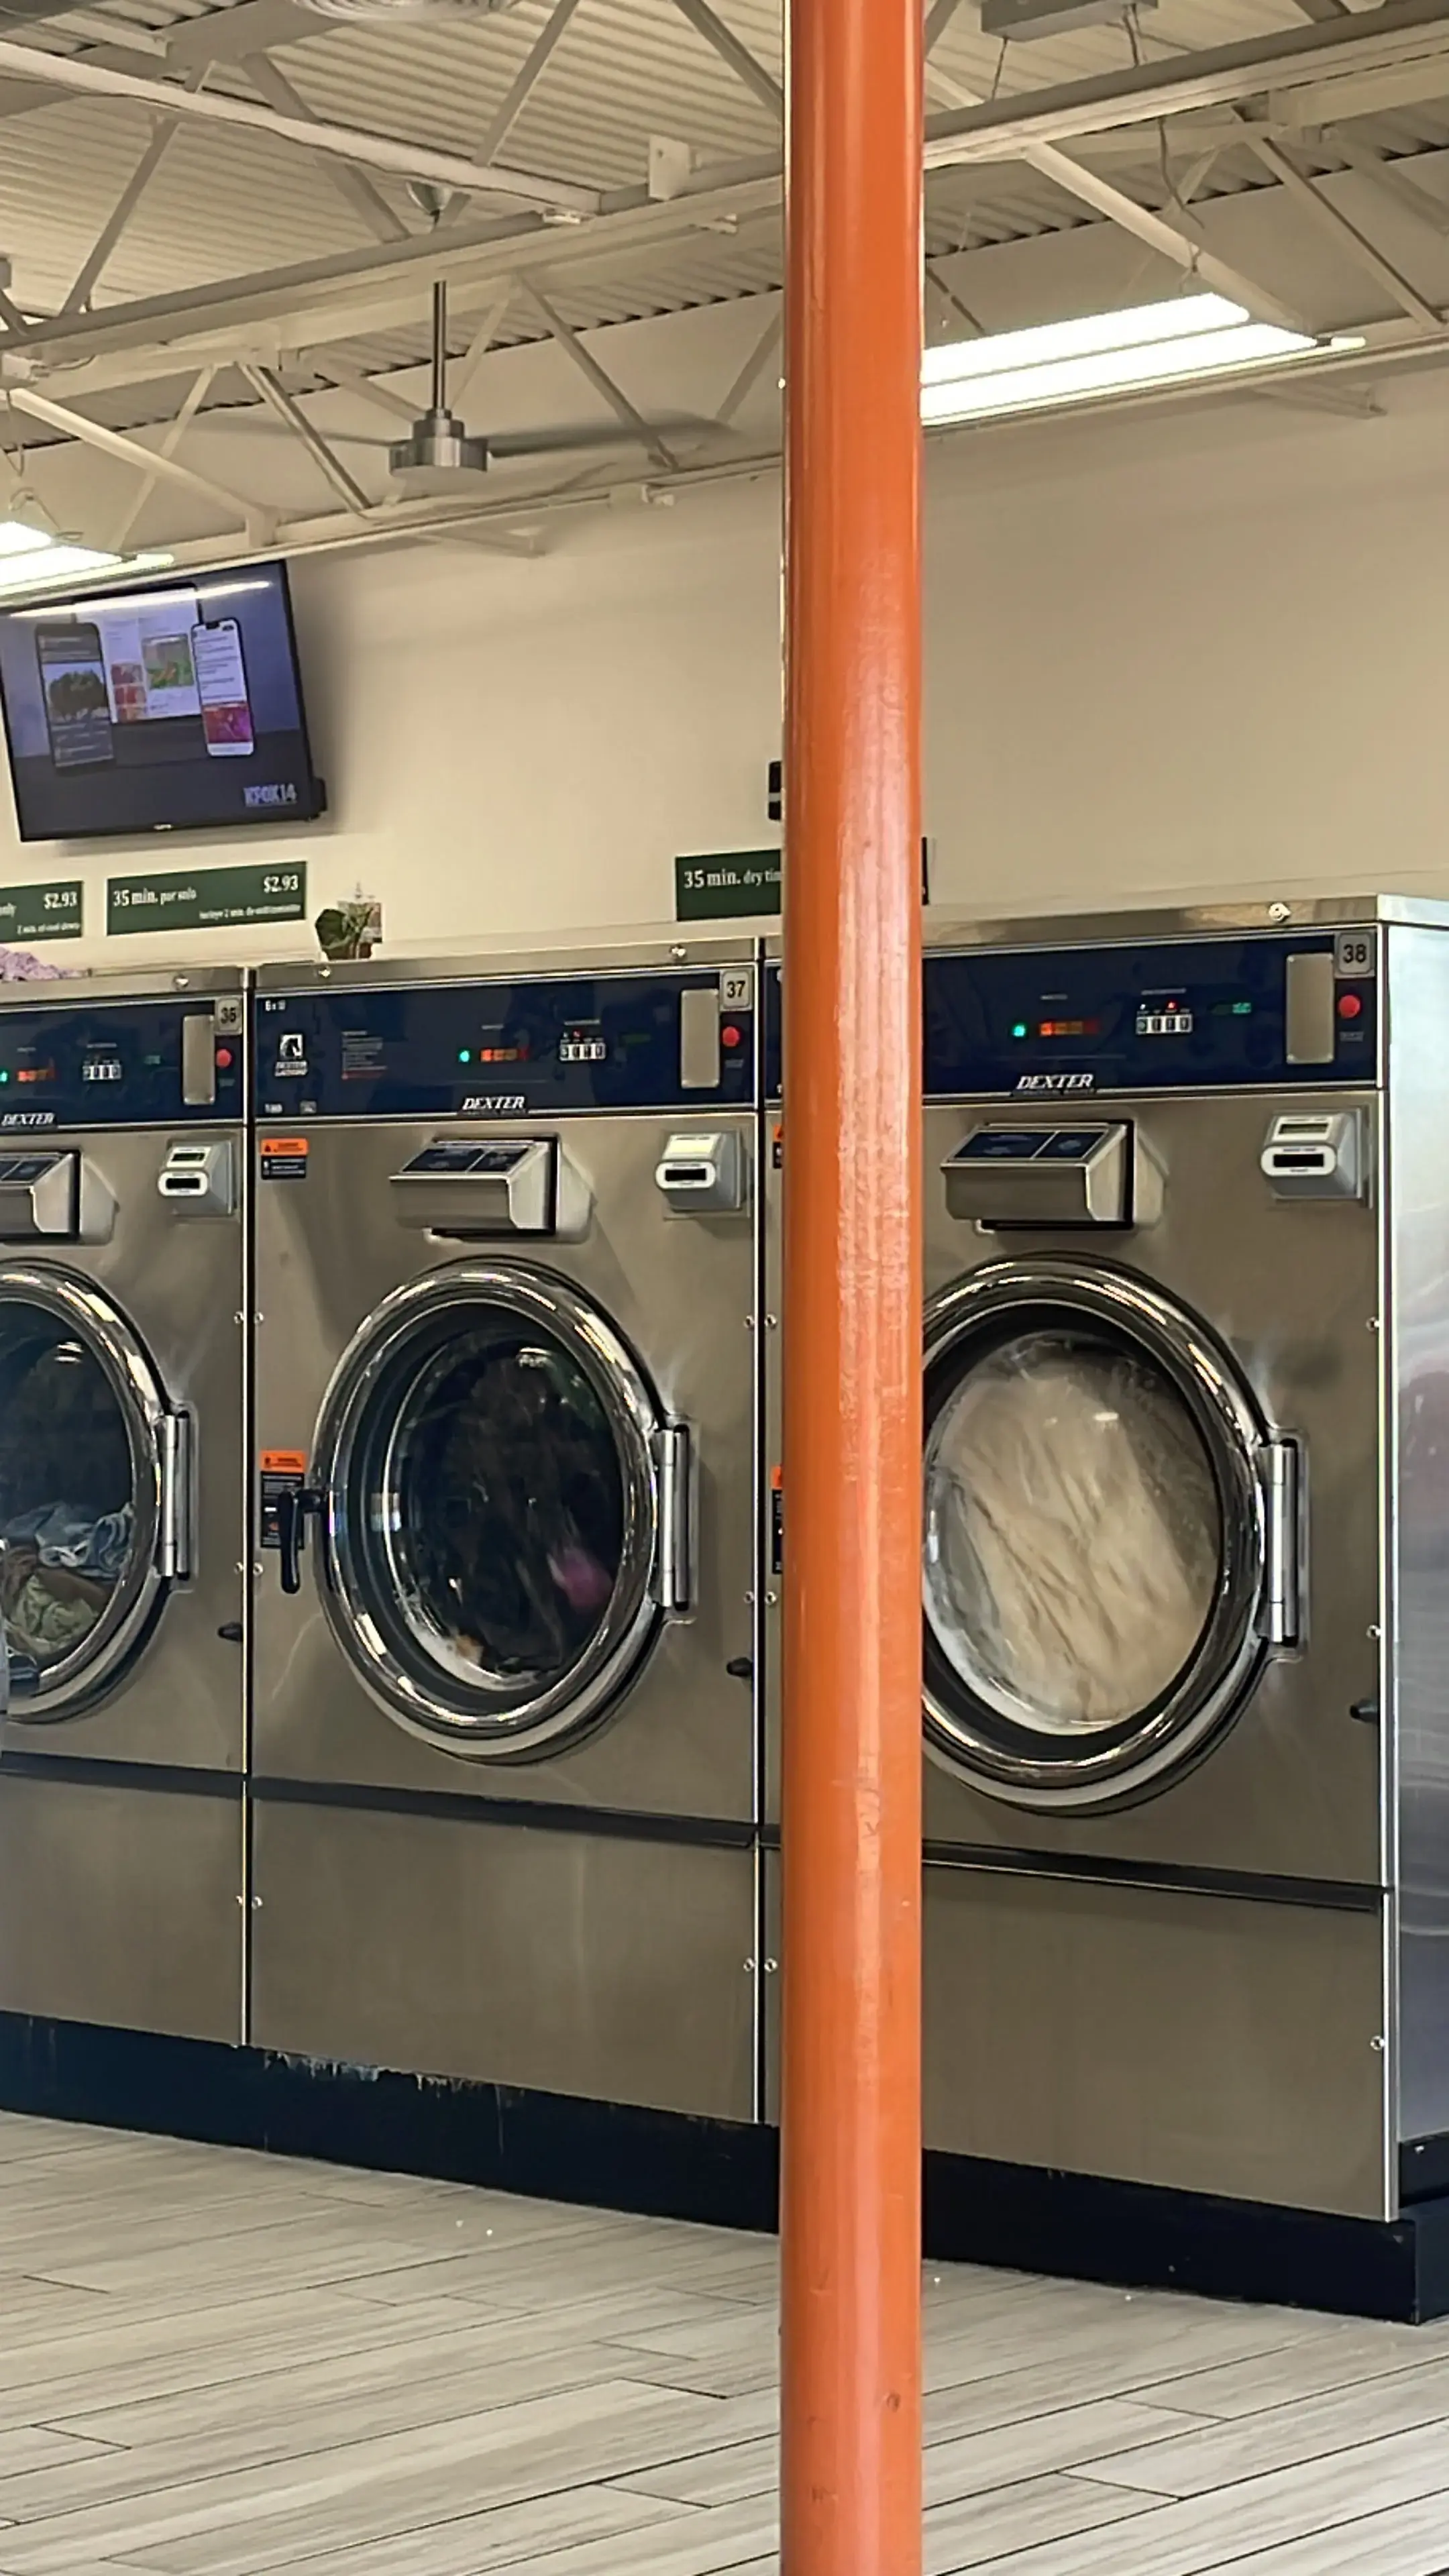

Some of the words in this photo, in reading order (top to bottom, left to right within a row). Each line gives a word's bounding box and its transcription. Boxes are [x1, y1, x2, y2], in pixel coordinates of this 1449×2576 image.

[263, 875, 299, 894] $2.93
[684, 870, 704, 889] 35
[707, 868, 741, 885] min.
[743, 869, 763, 887] dry
[44, 890, 78, 910] $2.93
[113, 889, 129, 906] 35
[131, 887, 158, 904] min.
[1343, 943, 1366, 964] 38
[727, 980, 746, 998] 37
[1016, 1074, 1093, 1089] DEXTER
[462, 1096, 525, 1110] DEXTER
[1, 1112, 54, 1126] DEXTER
